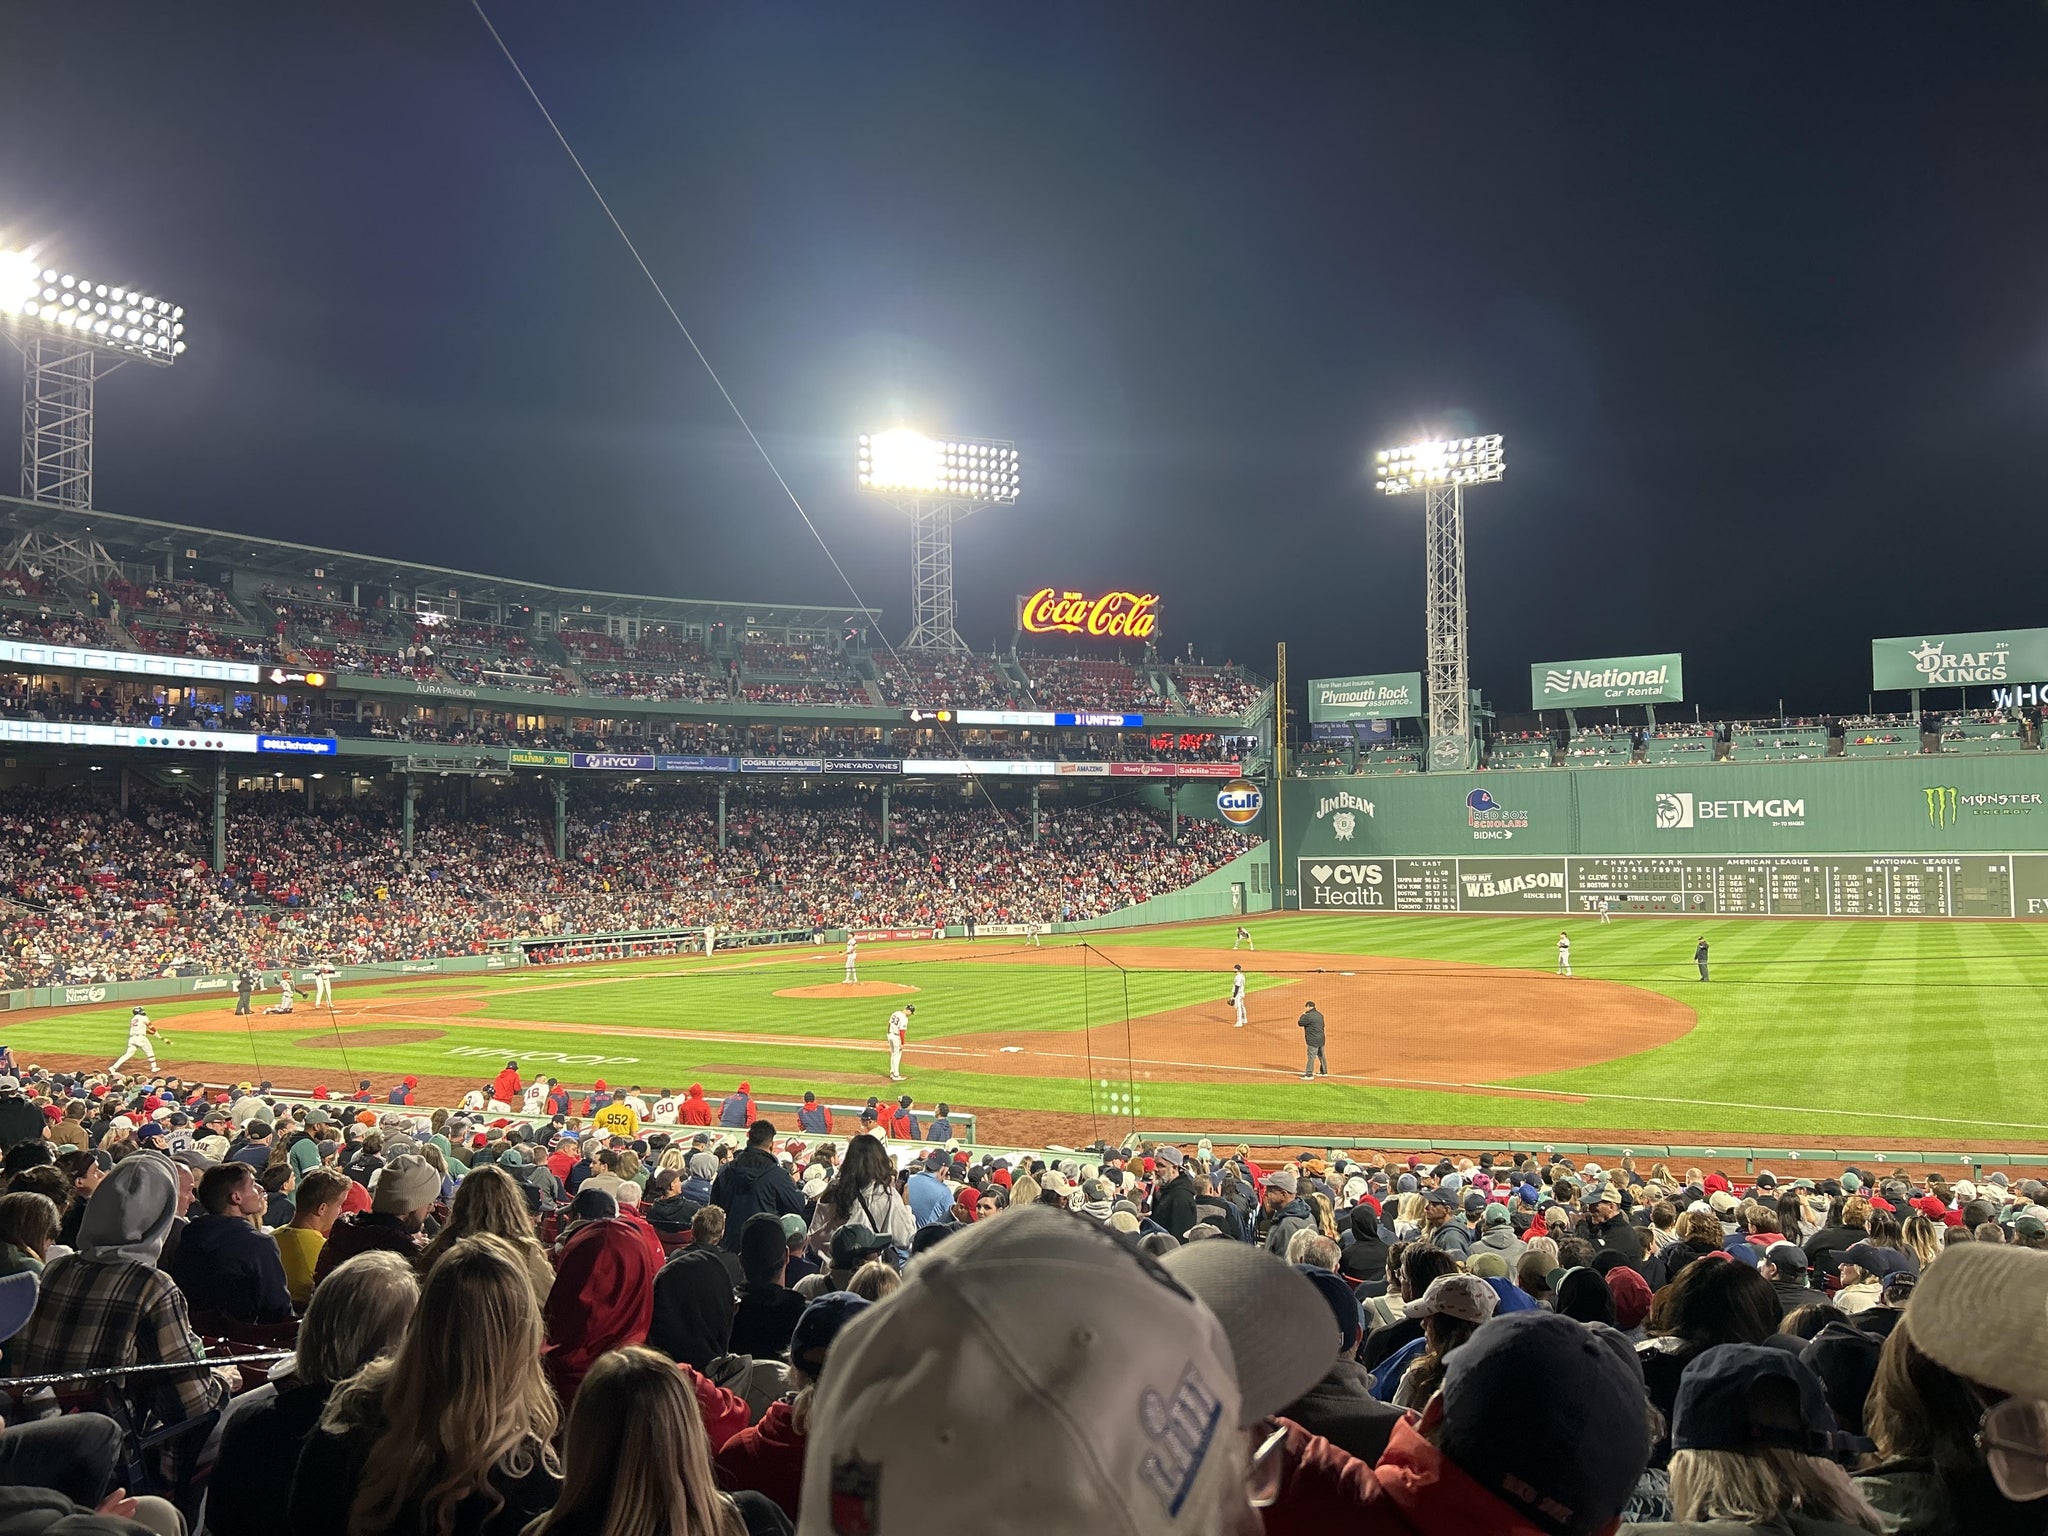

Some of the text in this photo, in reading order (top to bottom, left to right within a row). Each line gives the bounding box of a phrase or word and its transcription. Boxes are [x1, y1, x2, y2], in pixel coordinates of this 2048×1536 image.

[1022, 587, 1160, 638] Coca-Cola
[1916, 650, 2010, 673] DRAFT
[1928, 666, 2008, 684] KINGS
[442, 687, 477, 698] PAVILION
[1321, 685, 1408, 704] Plymouth Rock
[1605, 686, 1663, 698] Car Rental
[512, 755, 569, 765] SULLIVAN TIRE
[603, 757, 638, 767] HYCU
[742, 759, 776, 767] COGHLIN
[1179, 767, 1210, 775] Safelite
[1218, 793, 1260, 809] Gulf
[1316, 791, 1375, 819] JIM BEAM
[1961, 793, 2043, 807] MONSTER
[1473, 810, 1528, 820] RED SOX
[1698, 799, 1805, 819] BETMGM
[1473, 819, 1528, 828] SCHOLARS
[1473, 831, 1503, 840] BIDMC
[1333, 864, 1383, 885] CVS
[1284, 888, 1297, 897] 310
[1314, 886, 1384, 906] Health
[193, 978, 228, 991] Franklin
[65, 987, 90, 996] Ninety
[65, 994, 87, 1002] Nine
[450, 1046, 640, 1065] WHOOP
[526, 1087, 540, 1099] 16
[656, 1102, 674, 1115] 30
[606, 1113, 628, 1126] 952
